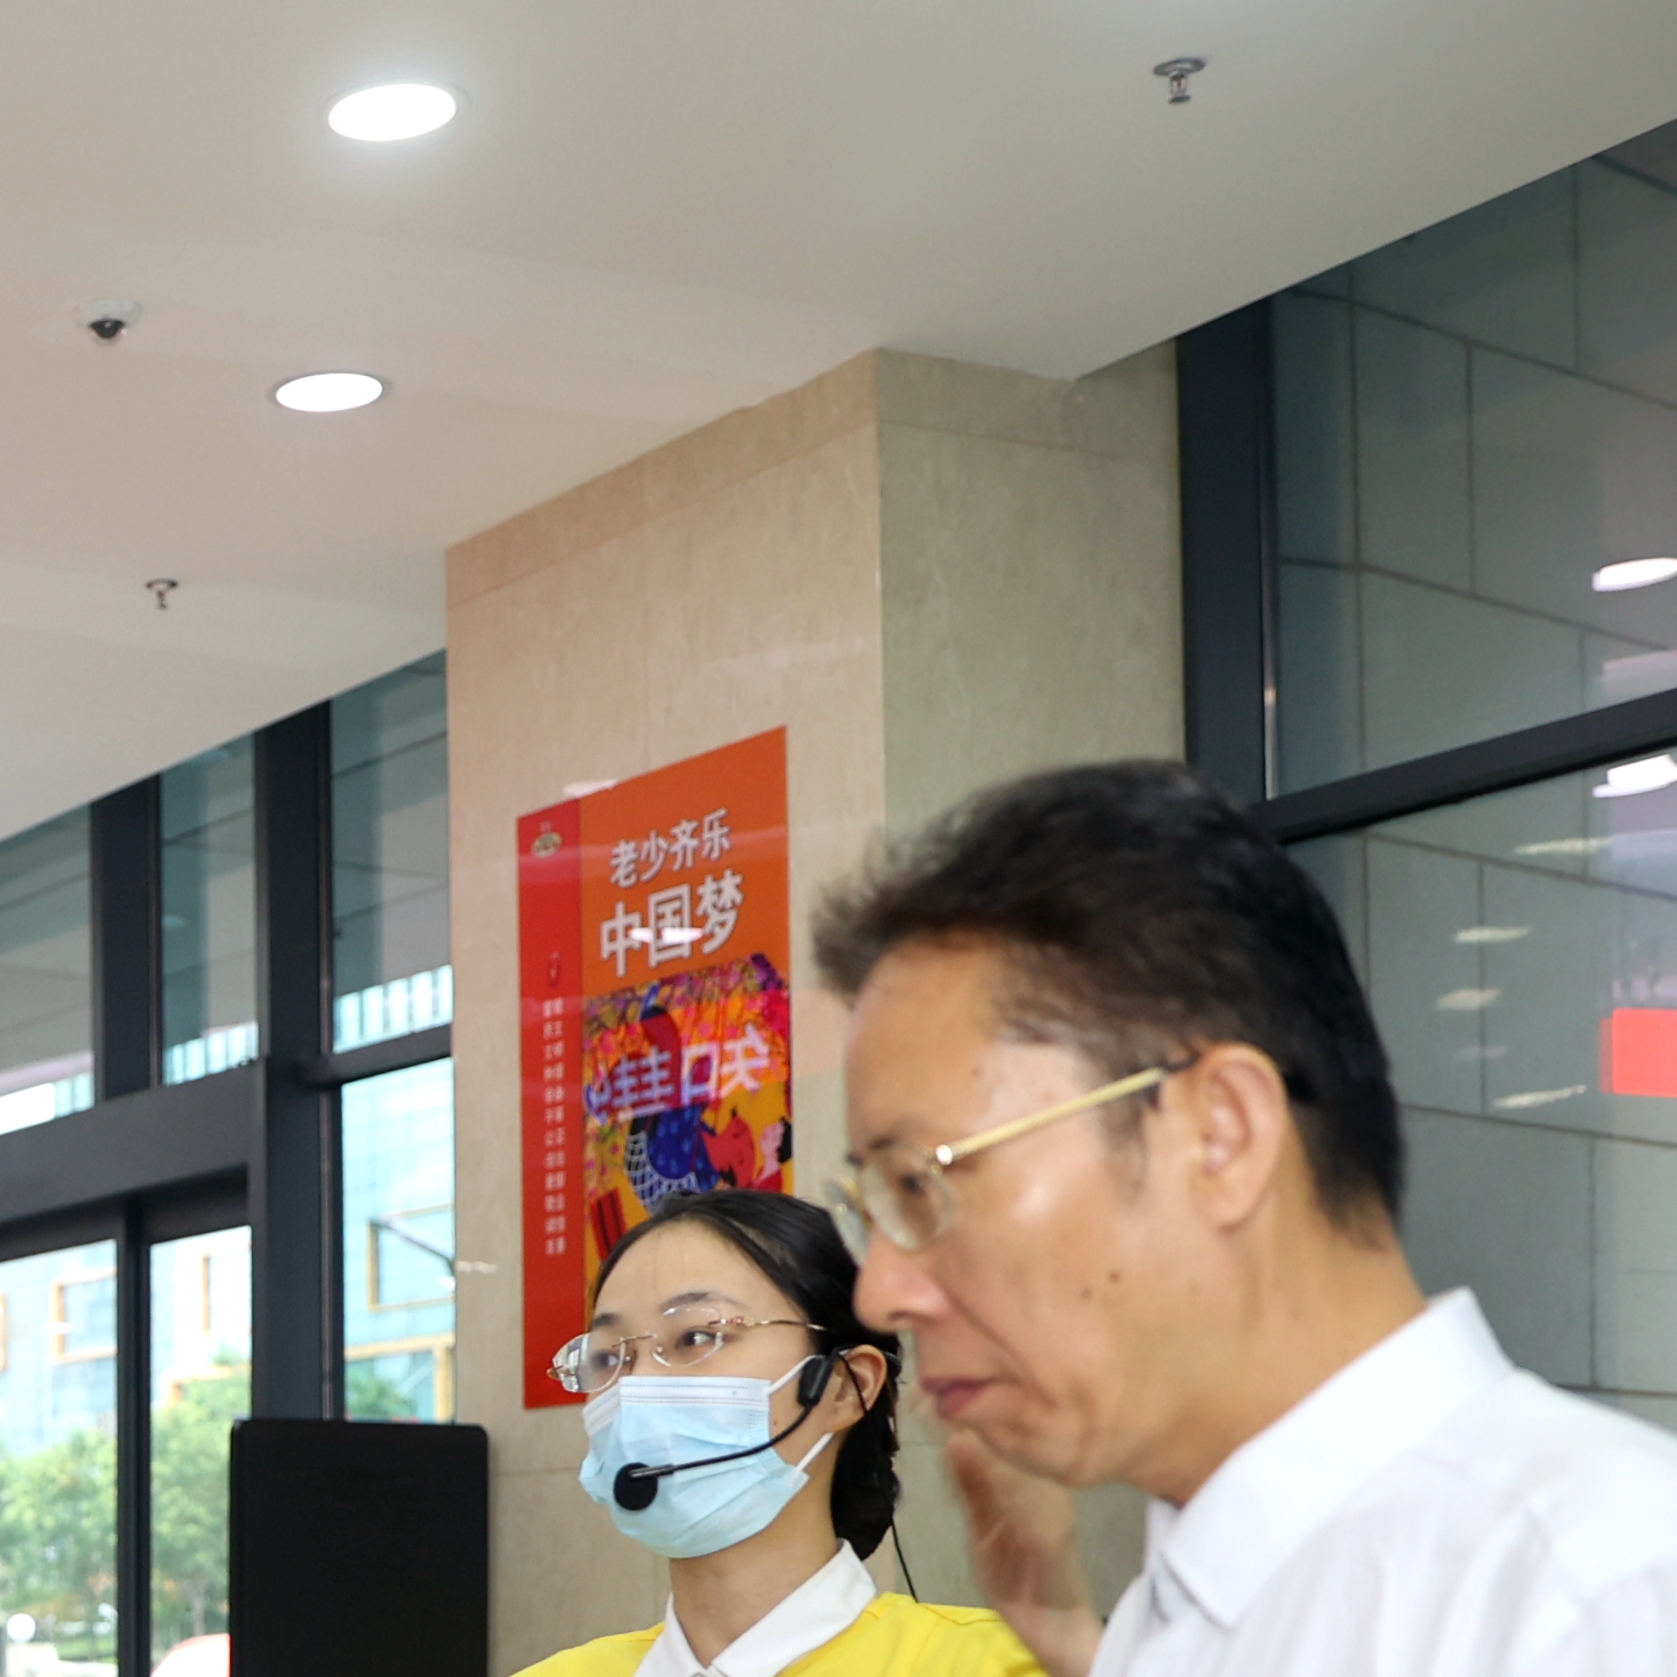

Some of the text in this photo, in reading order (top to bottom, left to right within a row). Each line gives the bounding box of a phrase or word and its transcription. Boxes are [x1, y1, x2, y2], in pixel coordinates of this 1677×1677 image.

[609, 806, 732, 889] 老少齐乐
[600, 867, 744, 978] 中国梦
